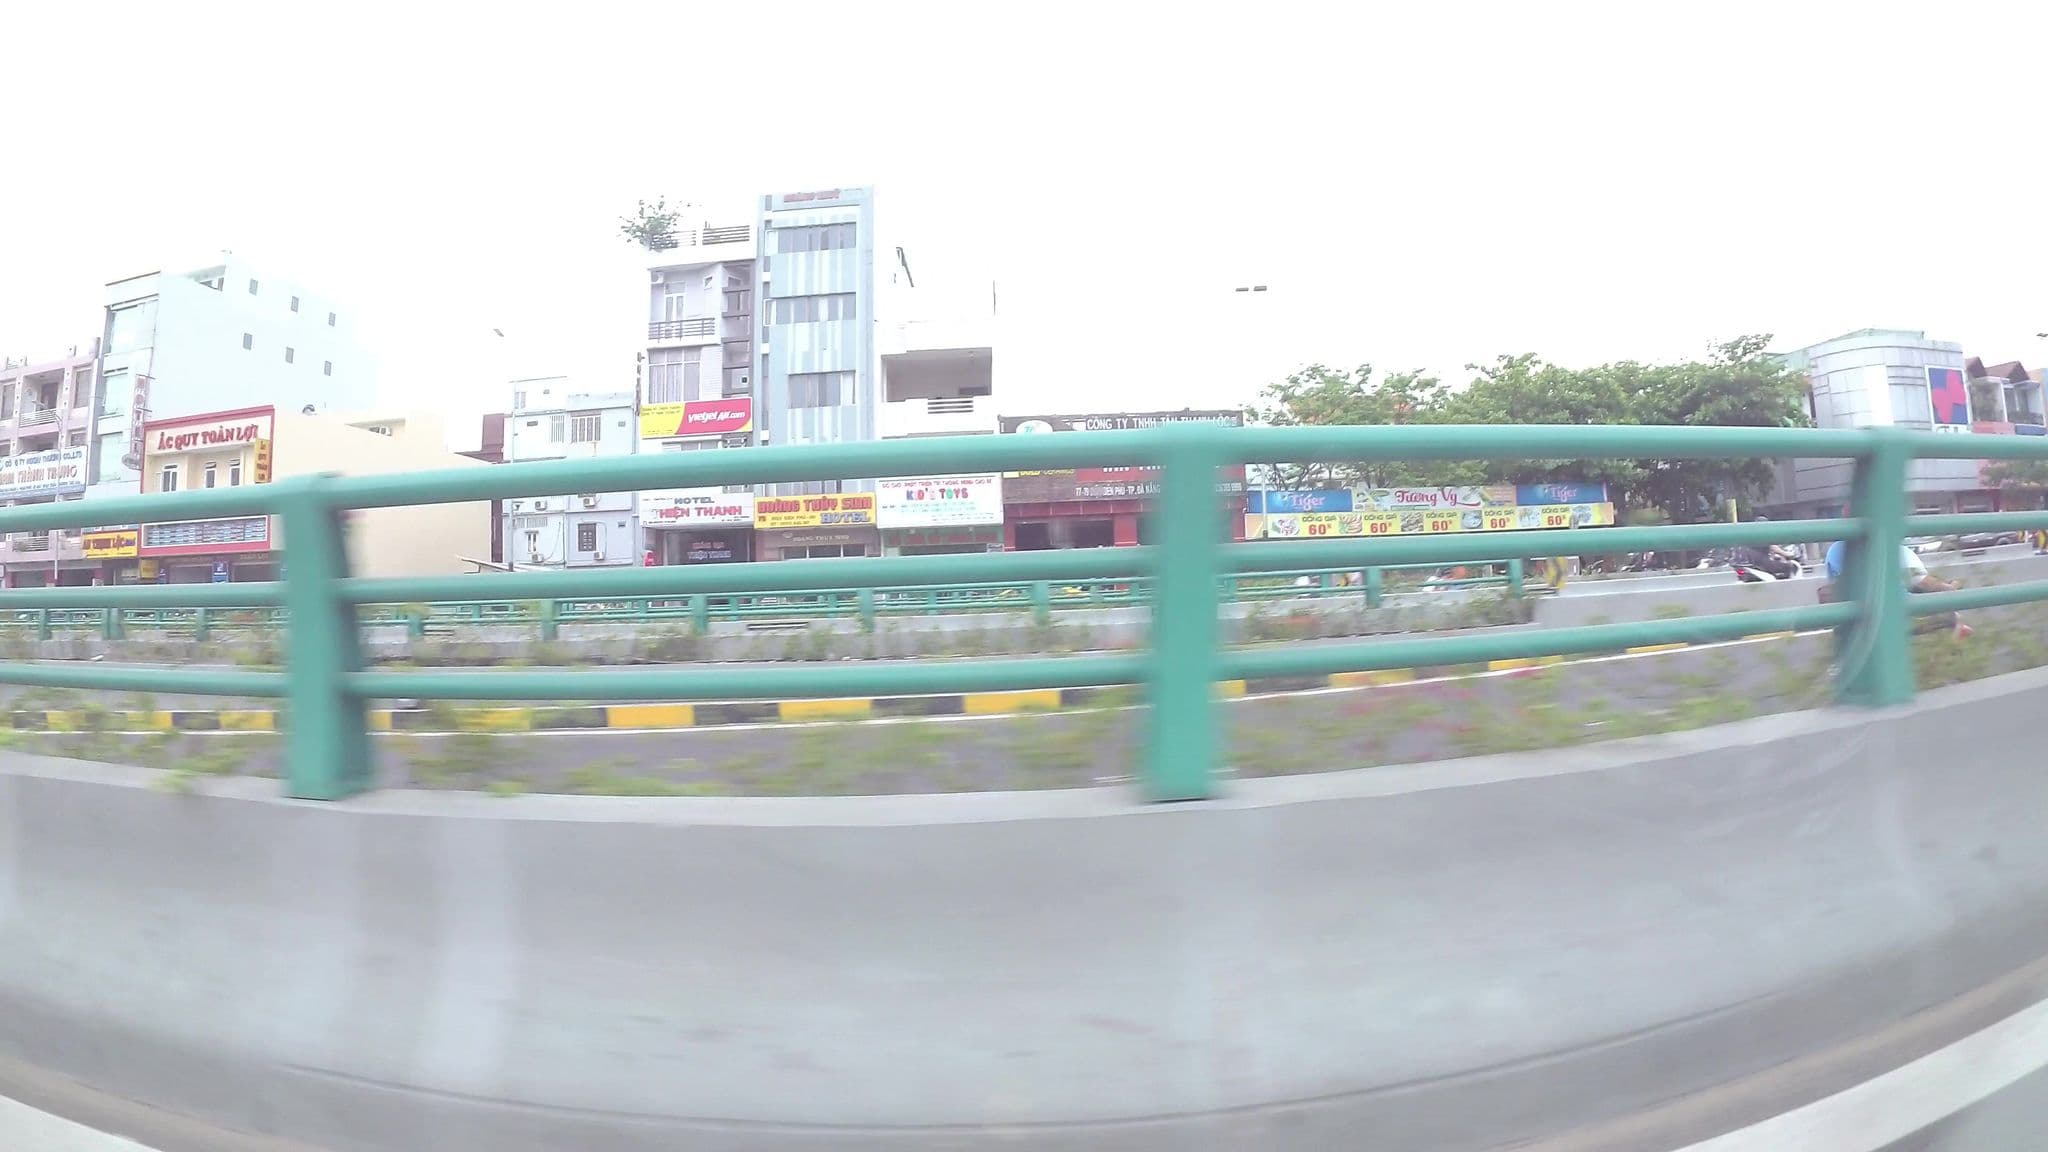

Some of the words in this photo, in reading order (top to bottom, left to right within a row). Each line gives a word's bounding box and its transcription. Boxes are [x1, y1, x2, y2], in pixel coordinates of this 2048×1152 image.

[1086, 417, 1113, 430] CÔNG
[1114, 418, 1128, 429] TY
[1132, 418, 1157, 429] TNHH
[939, 488, 968, 499] TOYS
[1440, 488, 1463, 506] Vy
[1552, 484, 1577, 502] Tiger
[674, 496, 715, 505] HOTEL
[1291, 493, 1326, 508] Tiger
[694, 505, 742, 516] THANH
[820, 511, 871, 524] HOTEL
